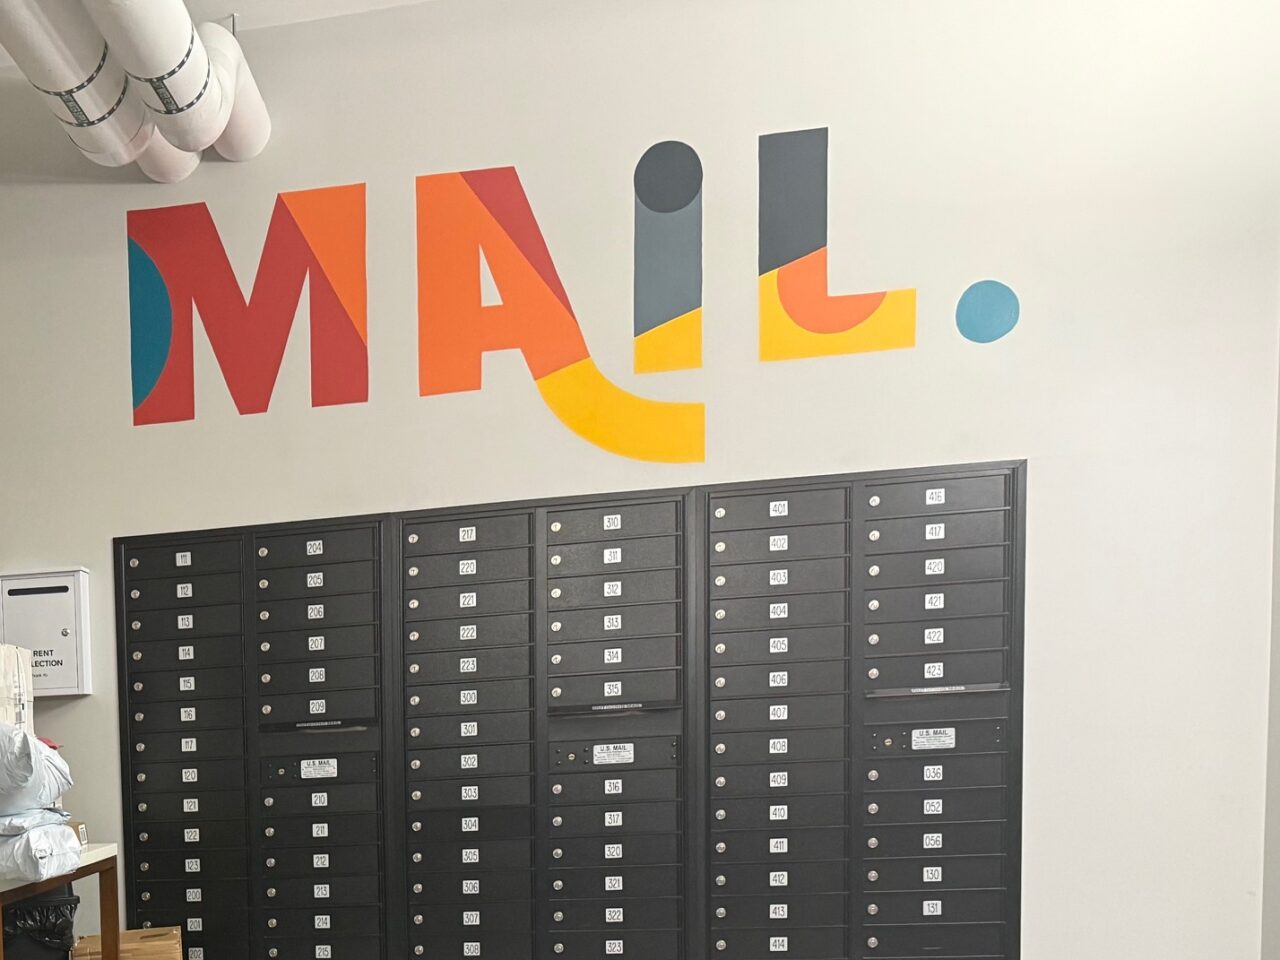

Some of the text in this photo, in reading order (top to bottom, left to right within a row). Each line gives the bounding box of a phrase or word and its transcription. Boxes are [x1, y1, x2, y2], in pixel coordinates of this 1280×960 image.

[771, 502, 787, 515] 401
[605, 515, 620, 529] 310
[461, 527, 475, 541] 217
[927, 525, 943, 538] 417
[307, 541, 322, 555] 204
[179, 553, 189, 565] 111
[607, 549, 619, 563] 311
[460, 561, 476, 574] 220
[926, 560, 944, 574] 420
[307, 573, 323, 587] 205
[770, 570, 788, 584] 403
[179, 584, 190, 597] 112
[605, 582, 620, 596] 312
[461, 594, 475, 607] 221
[927, 595, 942, 608] 421
[308, 605, 324, 619] 206
[770, 604, 787, 617] 404
[180, 616, 191, 628] 113
[605, 616, 620, 629] 313
[460, 626, 476, 639] 222
[925, 629, 942, 643] 422
[309, 637, 324, 650] 207
[770, 638, 788, 652] 405
[33, 649, 54, 657] RENT
[605, 649, 620, 663] 314
[31, 659, 63, 667] LECTION
[460, 658, 476, 672] 223
[309, 669, 325, 682] 208
[925, 664, 942, 678] 423
[182, 678, 193, 690] 115
[770, 673, 787, 686] 406
[605, 682, 620, 696] 315
[461, 691, 477, 704] 300
[310, 700, 325, 713] 209
[770, 706, 787, 719] 407
[462, 723, 476, 736] 301
[184, 739, 194, 751] 117
[770, 739, 787, 753] 408
[461, 755, 477, 768] 302
[183, 769, 197, 782] 120
[770, 773, 788, 786] 409
[924, 766, 942, 780] 036
[606, 780, 621, 793] 316
[313, 793, 327, 806] 210
[462, 787, 478, 800] 303
[185, 799, 197, 811] 121
[924, 800, 942, 814] 052
[607, 812, 621, 826] 317
[771, 806, 787, 819] 410
[314, 824, 326, 837] 211
[462, 818, 478, 831] 304
[185, 829, 198, 841] 122
[924, 834, 942, 848] 056
[605, 845, 622, 858] 320
[772, 839, 785, 851] 411
[463, 849, 479, 862] 305
[186, 859, 200, 872] 123
[771, 872, 786, 885] 412
[925, 868, 941, 881] 130
[463, 881, 479, 893] 306
[607, 877, 621, 890] 321
[187, 889, 201, 901] 200
[771, 905, 786, 918] 413
[926, 901, 939, 915] 131
[464, 912, 479, 925] 307
[606, 909, 622, 922] 322
[188, 919, 202, 931] 201
[464, 943, 480, 956] 308
[606, 941, 623, 953] 323
[771, 938, 786, 950] 414
[189, 948, 203, 960] 202
[317, 946, 330, 958] 215
